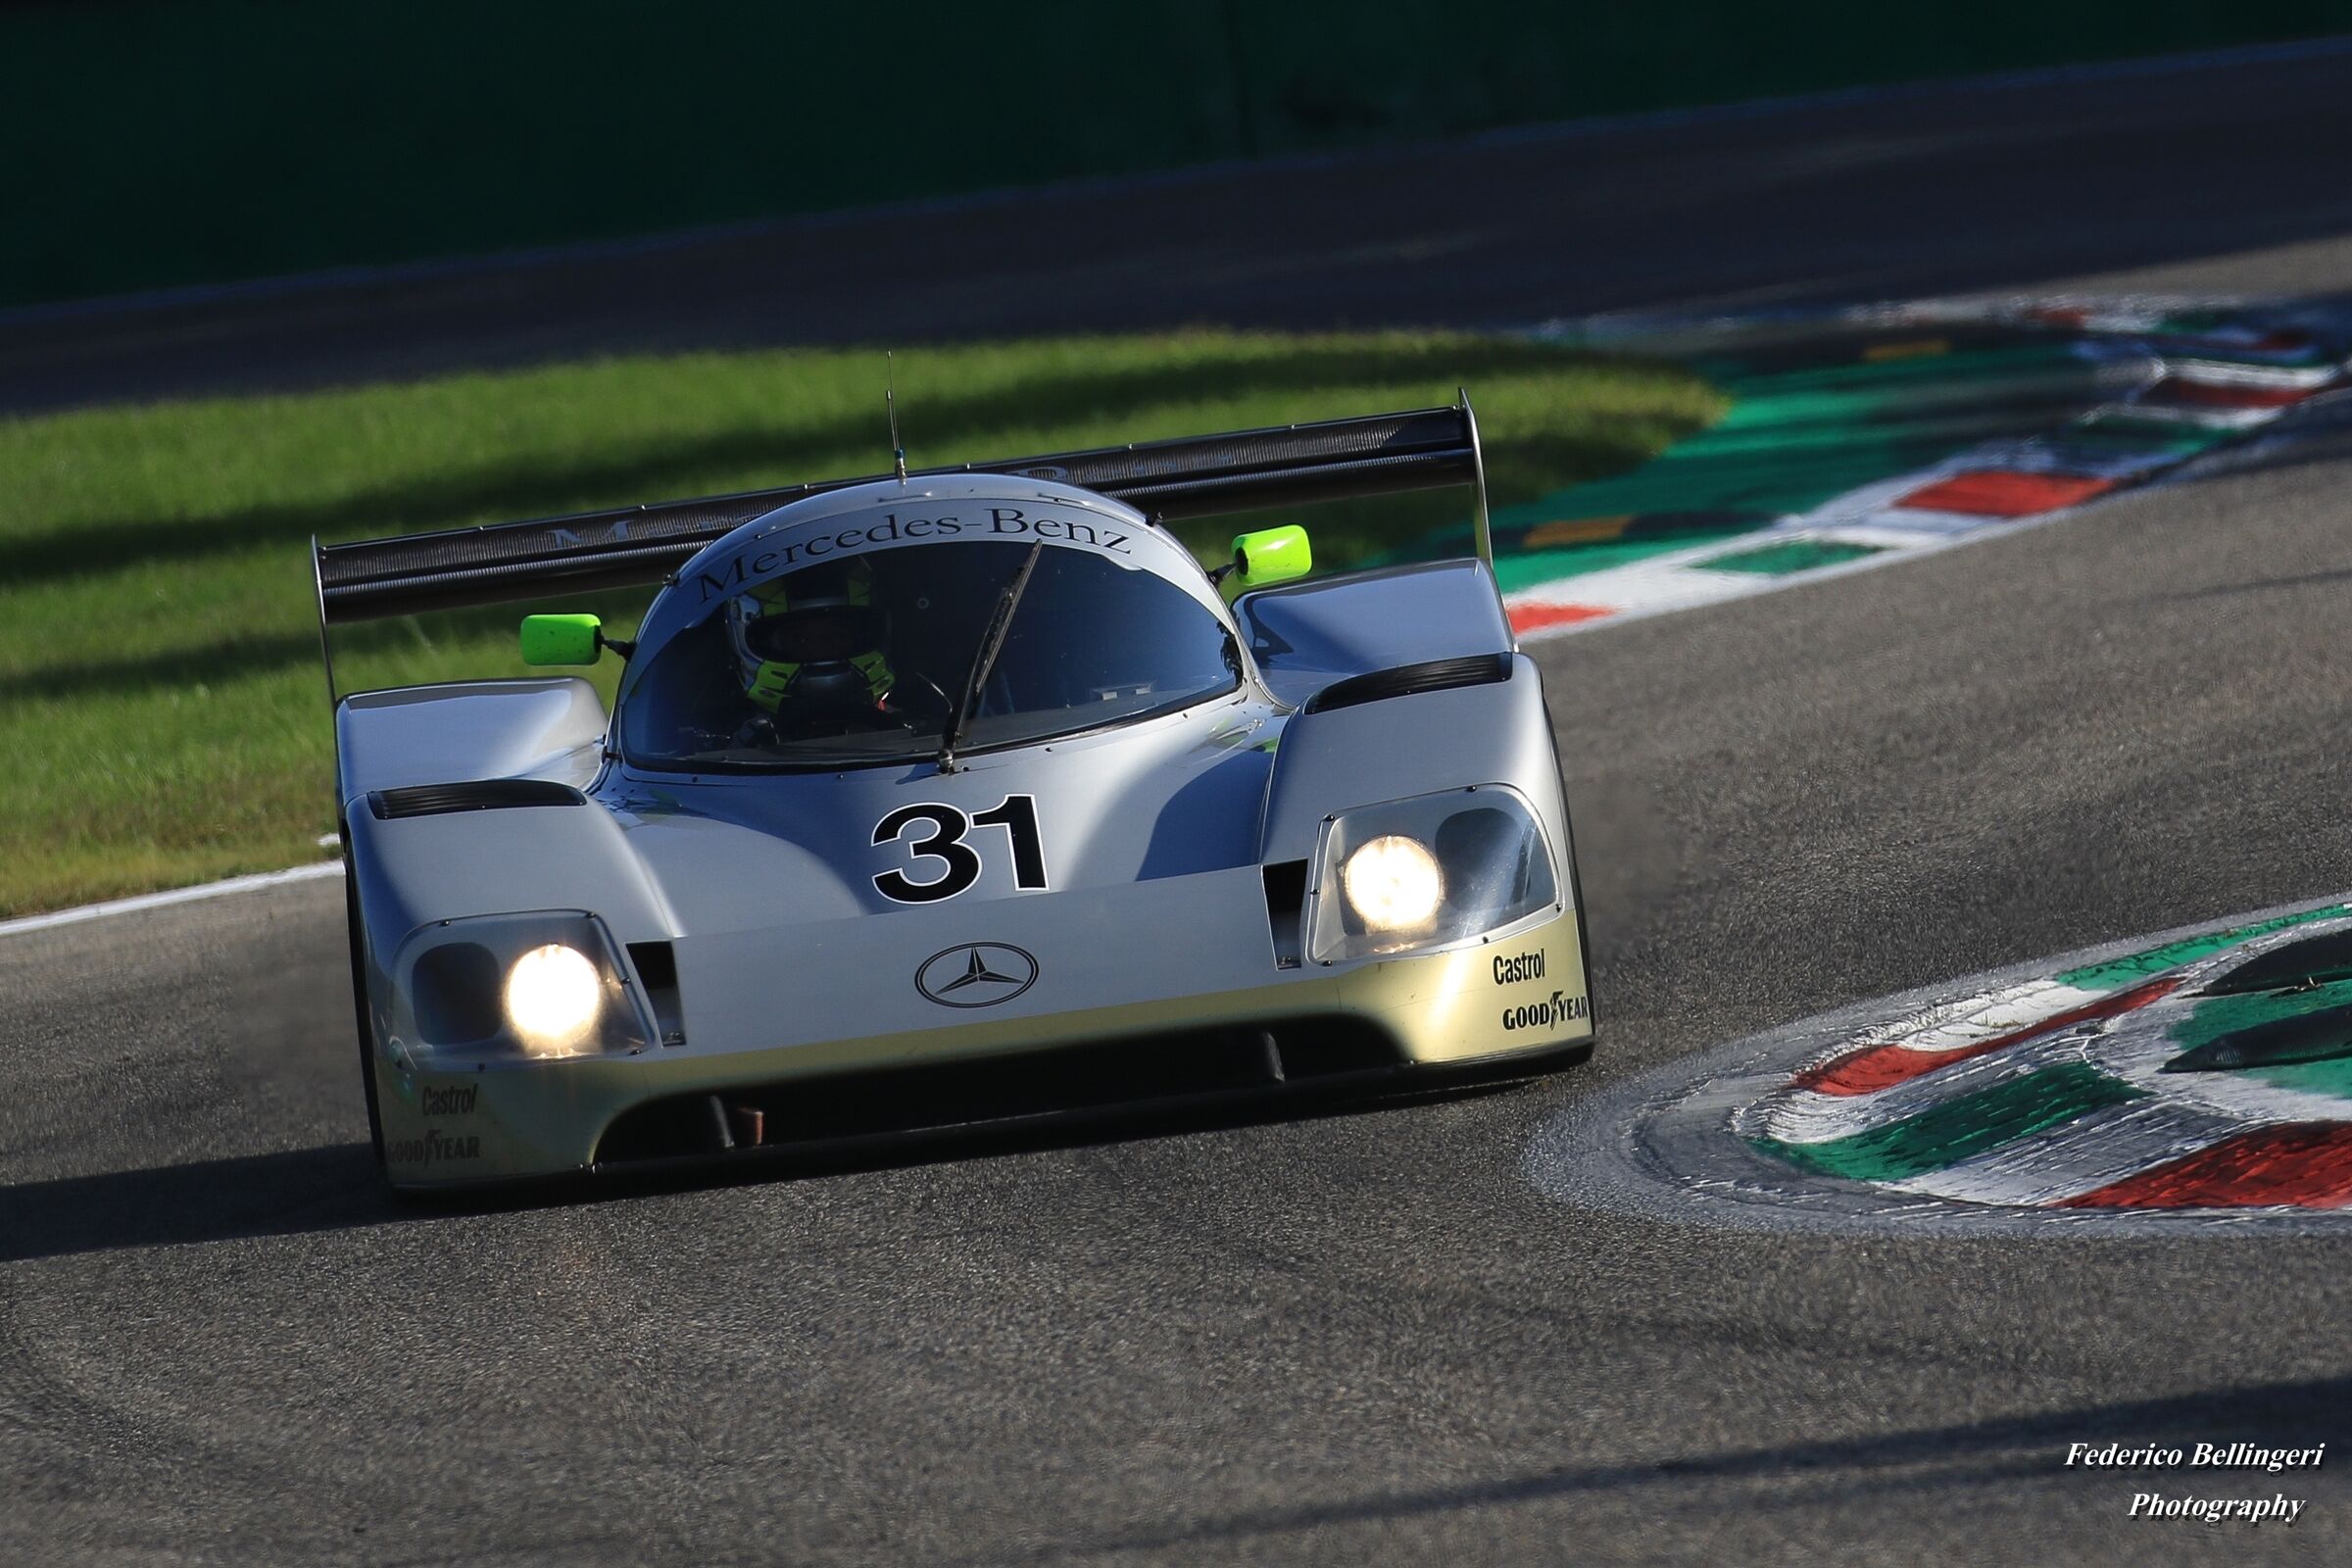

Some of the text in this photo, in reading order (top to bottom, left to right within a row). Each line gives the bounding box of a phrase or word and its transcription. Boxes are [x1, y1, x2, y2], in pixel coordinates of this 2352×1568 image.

[697, 508, 1132, 604] Mercedes-Benz
[871, 794, 1050, 905] 31
[1493, 948, 1545, 985] Castrol
[1502, 991, 1589, 1031] GOODYEAR
[422, 1083, 479, 1116] Castrol
